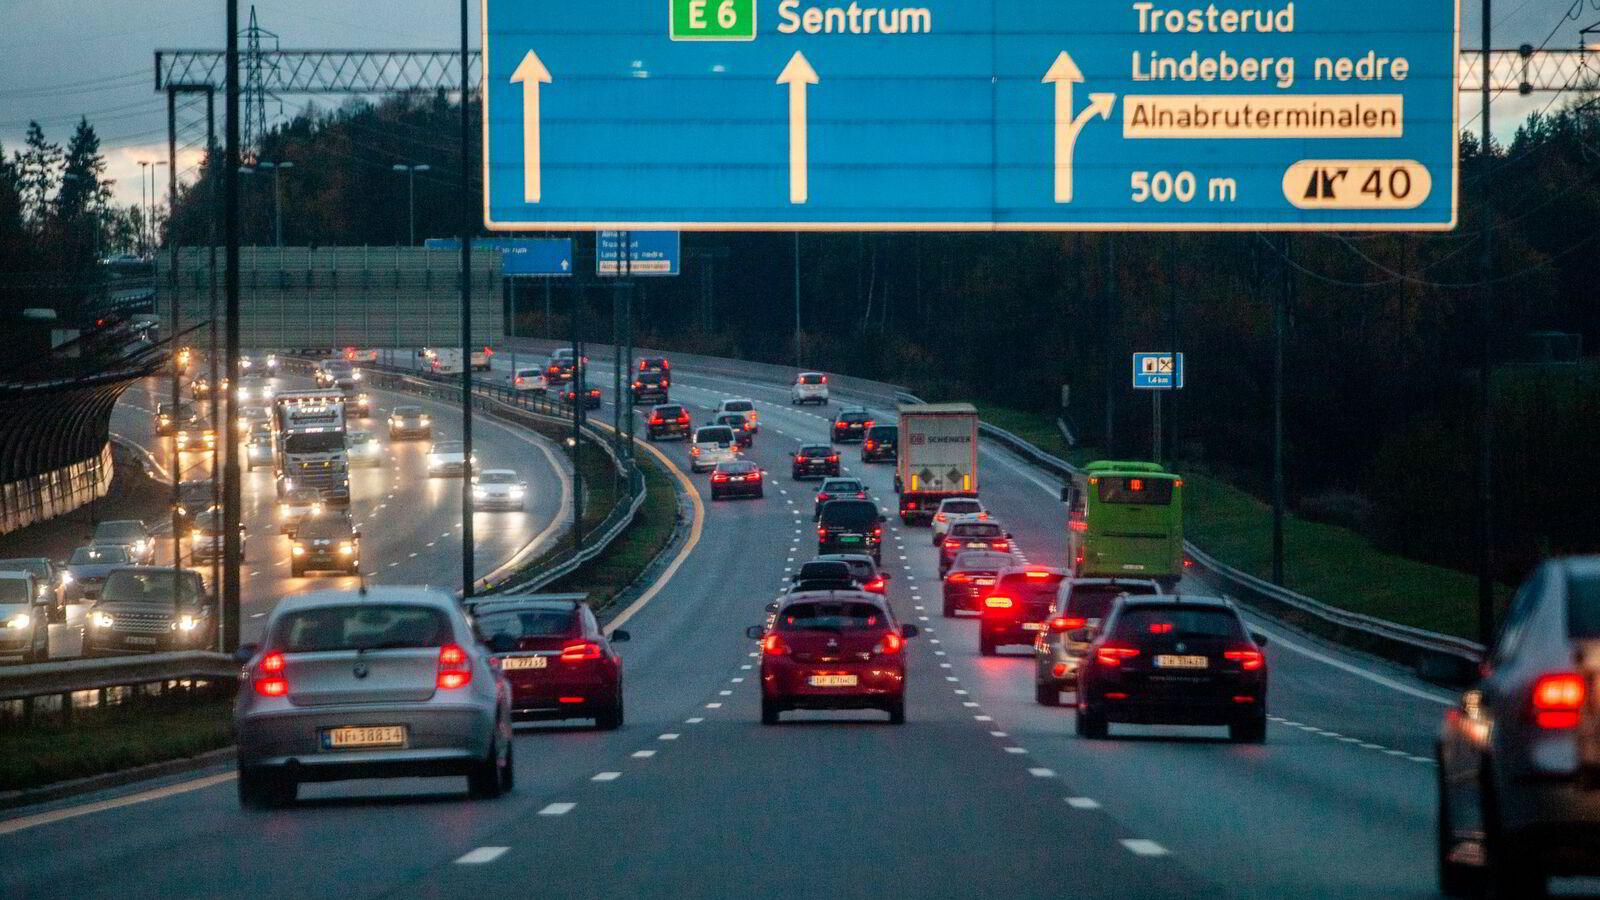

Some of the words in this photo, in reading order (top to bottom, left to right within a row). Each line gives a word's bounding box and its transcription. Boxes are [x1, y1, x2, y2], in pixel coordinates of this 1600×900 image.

[688, 0, 707, 29] E
[717, 0, 737, 29] 6
[777, 0, 932, 34] Sentrum
[1133, 2, 1294, 33] Trosterud
[1132, 50, 1294, 88] Lindeberg
[1314, 50, 1409, 81] nedre
[1130, 102, 1397, 129] Alnabruterminalen
[1130, 171, 1196, 203] 500
[1209, 177, 1236, 202] m
[1360, 168, 1411, 200] 40
[928, 435, 970, 443] SCHENKER
